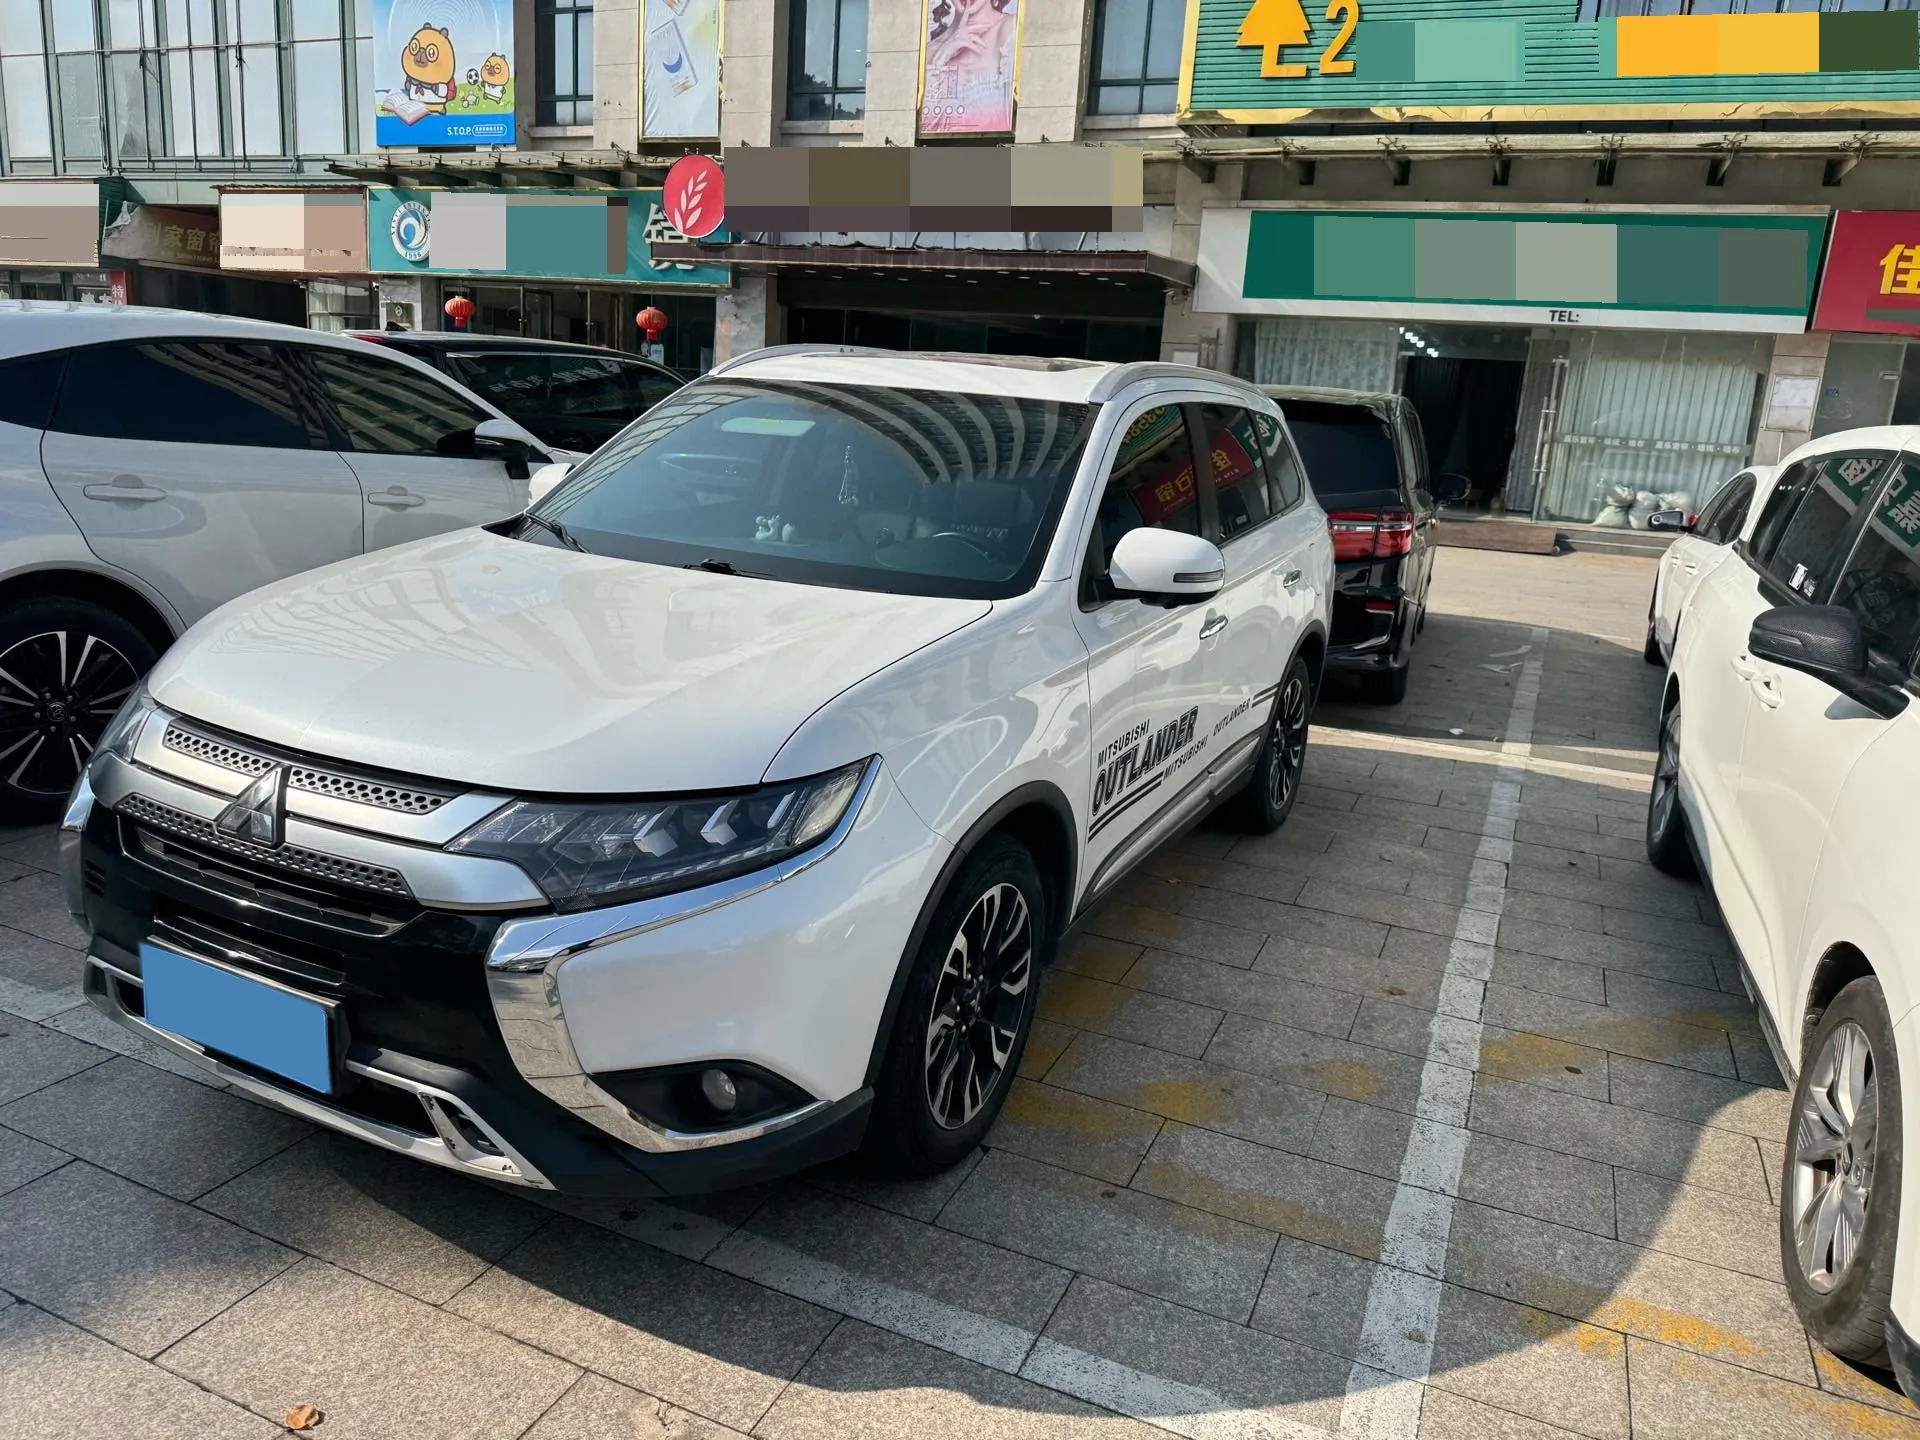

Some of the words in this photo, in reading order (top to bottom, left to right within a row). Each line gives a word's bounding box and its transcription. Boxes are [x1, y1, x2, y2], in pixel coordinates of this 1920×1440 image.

[1549, 310, 1579, 322] TEL:
[1212, 698, 1250, 737] OUTLANDER
[1092, 705, 1199, 816] OUTLANDER
[1097, 719, 1150, 768] MITSUBISHI
[1162, 734, 1208, 782] MITSUBISHI
